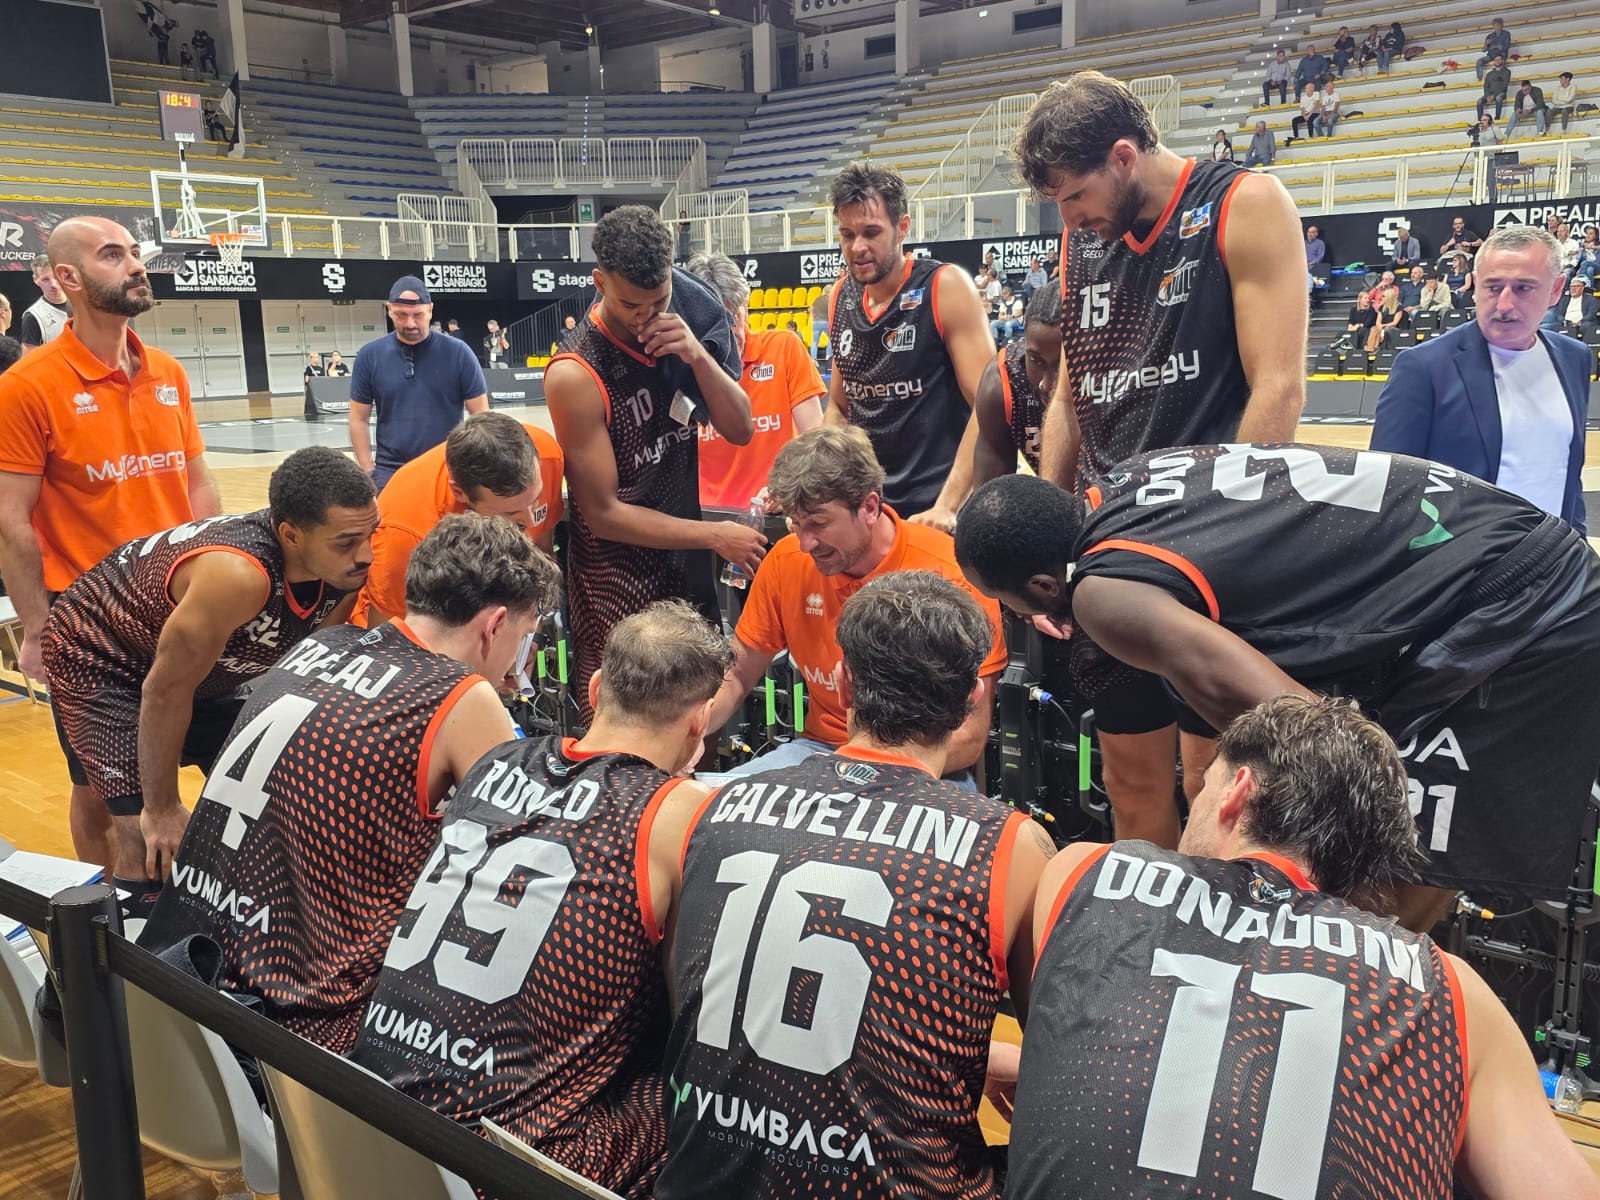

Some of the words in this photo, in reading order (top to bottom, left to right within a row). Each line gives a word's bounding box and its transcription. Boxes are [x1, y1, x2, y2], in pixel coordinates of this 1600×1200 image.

[198, 260, 255, 275] PREALPI
[443, 265, 486, 278] PREALPI
[1004, 239, 1059, 256] PREALPI
[198, 274, 256, 287] SANBIAGIO
[443, 277, 487, 288] SANBIAGIO
[1079, 282, 1111, 329] 15
[840, 329, 853, 357] 8
[626, 388, 654, 427] 10
[202, 693, 318, 851] 4
[710, 782, 980, 870] CALVELLINI
[171, 860, 270, 935] VUMBACA
[384, 818, 577, 1005] 99
[1092, 850, 1426, 993] DONADONI
[696, 850, 895, 1076] 16
[364, 1000, 494, 1077] VUMBACA
[411, 1053, 469, 1083] SOLUTIONS
[1136, 948, 1346, 1200] 11
[694, 1085, 877, 1167] VUMBACA
[707, 1129, 763, 1152] MOBILITY
[771, 1150, 850, 1177] SOLUTIONS
